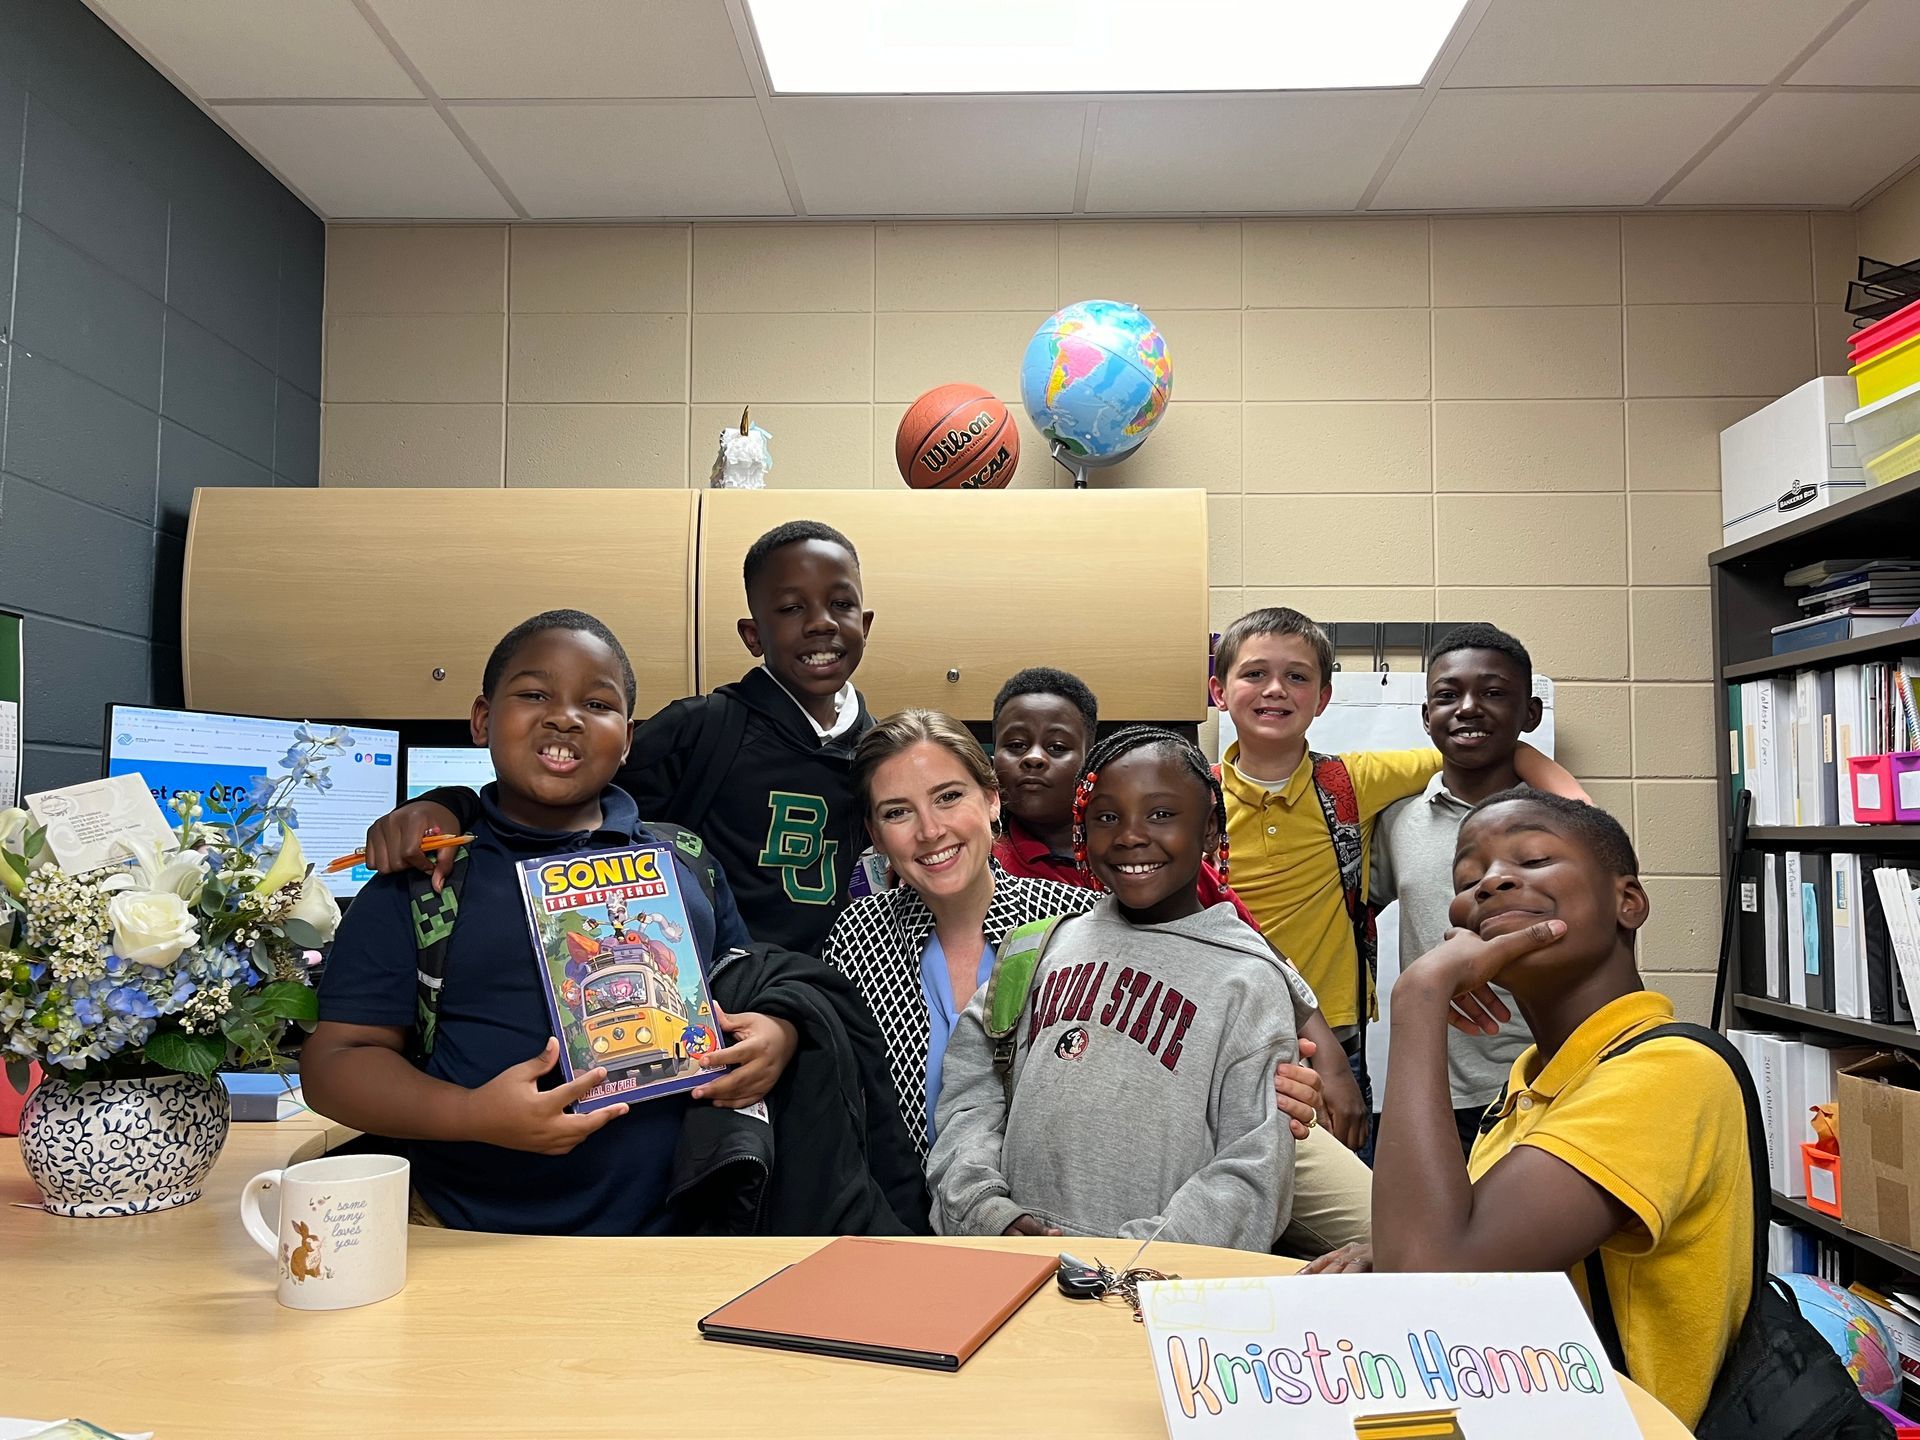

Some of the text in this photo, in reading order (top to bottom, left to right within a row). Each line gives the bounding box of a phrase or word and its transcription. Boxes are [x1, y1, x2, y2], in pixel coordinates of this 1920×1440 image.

[920, 411, 994, 473] Wilson
[960, 446, 1011, 489] NCAA
[1780, 489, 1816, 508] BANKERS BOX
[758, 791, 838, 905] BU
[543, 853, 658, 894] SONIC
[548, 894, 579, 909] THE
[1100, 966, 1198, 1071] STATE
[606, 1080, 618, 1092] BY
[618, 1078, 637, 1091] FIRE
[337, 1200, 367, 1211] some
[323, 1209, 365, 1225] bunny
[332, 1222, 362, 1237] loves
[333, 1238, 360, 1253] you
[1167, 1328, 1605, 1419] Kristin Hanna
